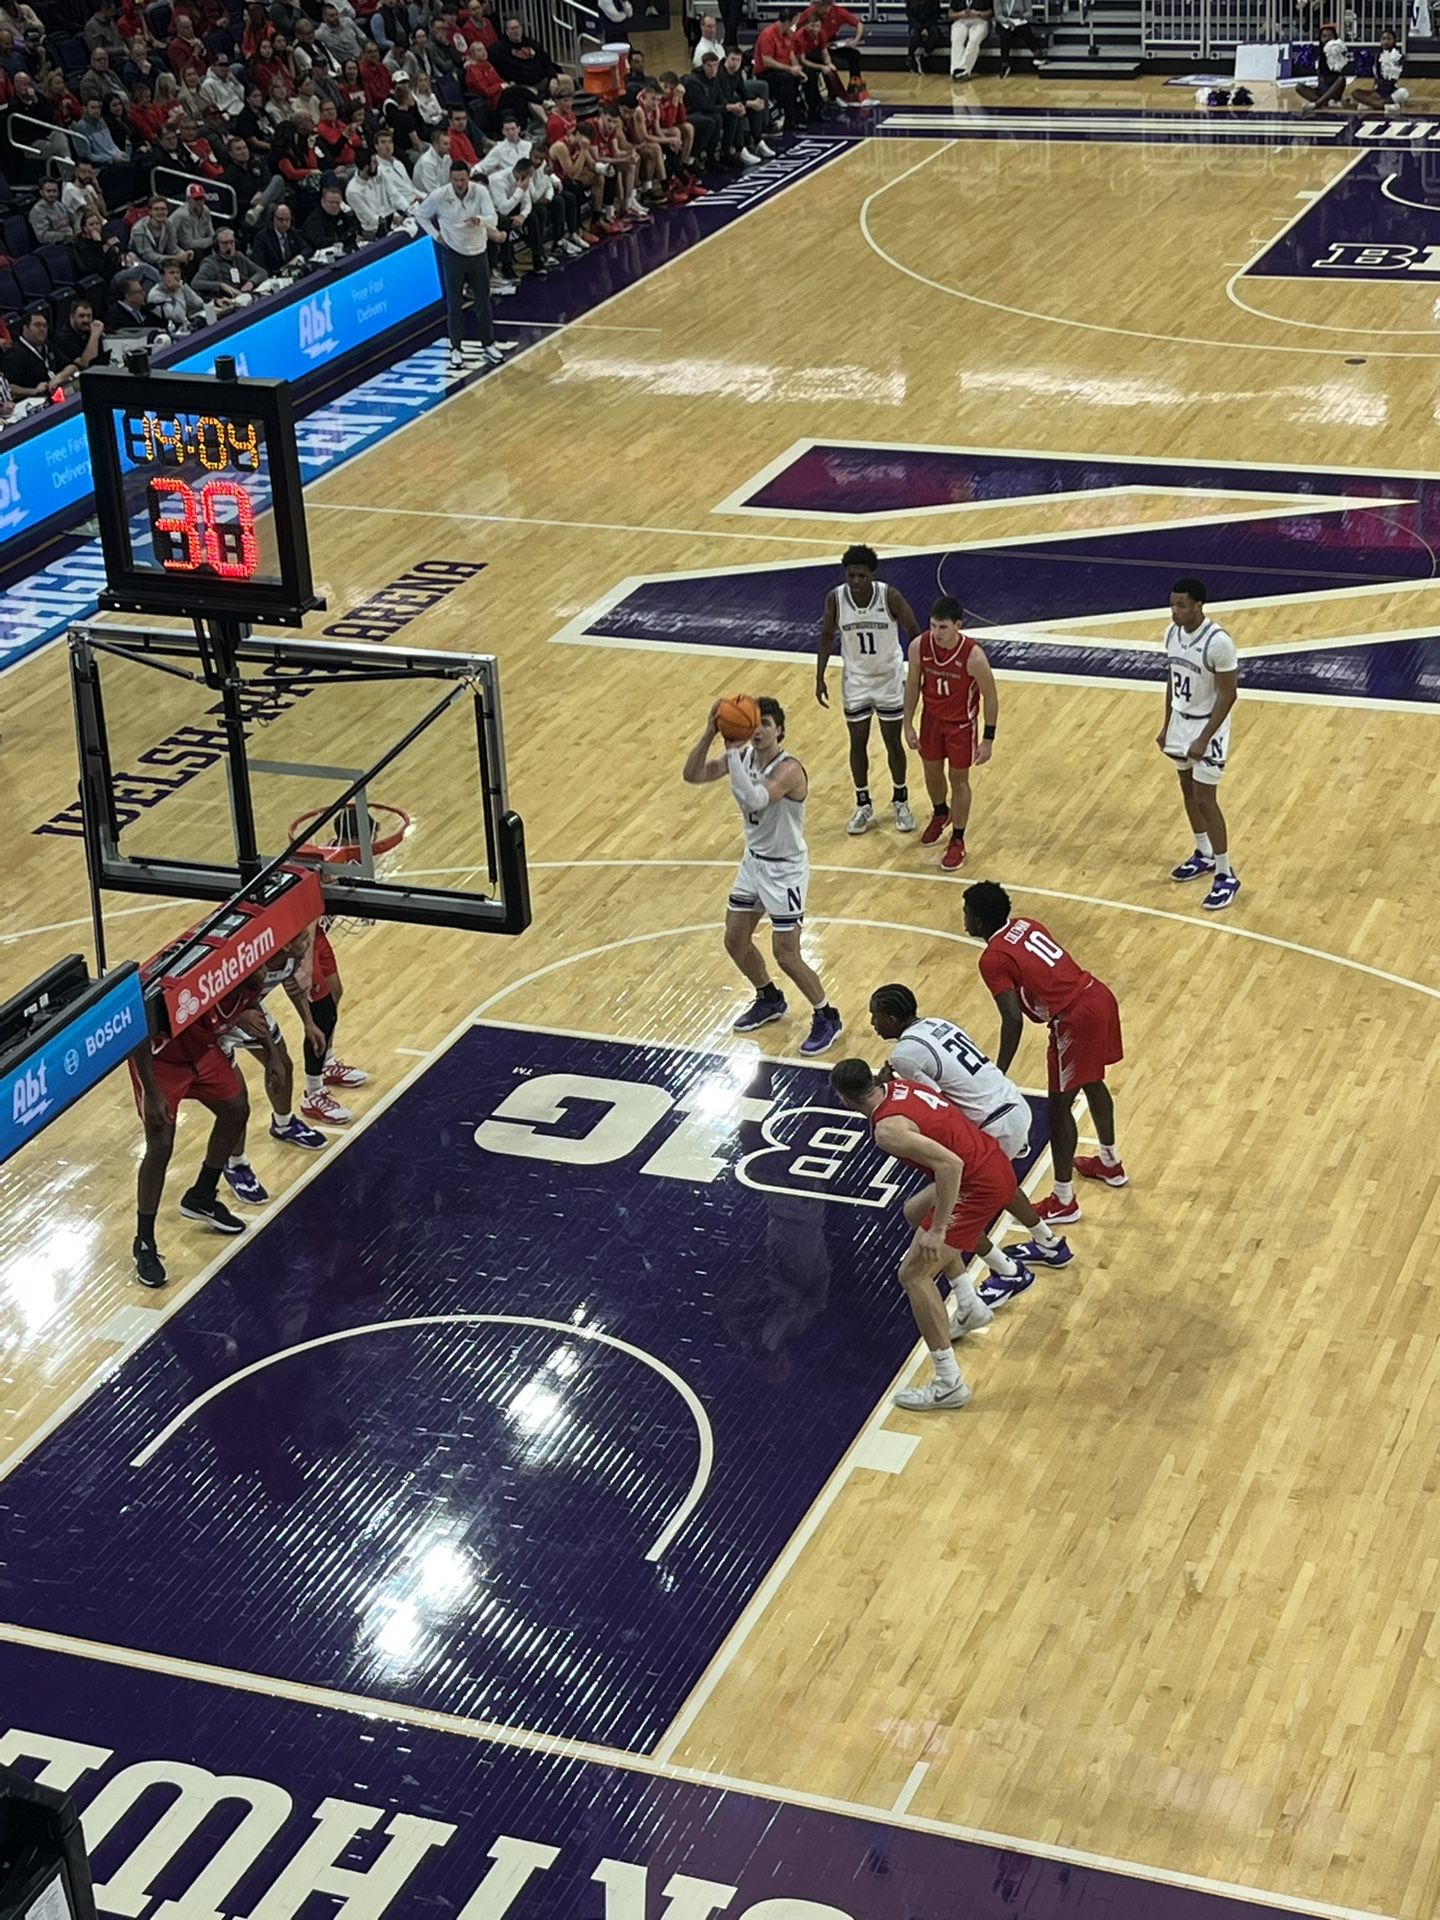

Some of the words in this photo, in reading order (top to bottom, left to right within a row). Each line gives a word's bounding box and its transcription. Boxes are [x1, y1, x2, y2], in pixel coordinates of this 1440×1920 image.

[685, 139, 834, 207] WINTRUST
[299, 288, 334, 349] Abt
[45, 446, 68, 467] Free
[142, 415, 259, 471] 14:04
[150, 476, 258, 578] 30
[322, 560, 489, 642] ARENA
[856, 632, 877, 655] 11
[936, 677, 951, 696] 11
[1173, 671, 1192, 702] 24
[1210, 737, 1223, 758] N
[787, 886, 802, 912] N
[1023, 930, 1064, 968] 10
[85, 1006, 132, 1058] BOSCH
[942, 1032, 990, 1076] 20
[13, 1057, 48, 1121] Abt
[913, 1089, 949, 1111] 4
